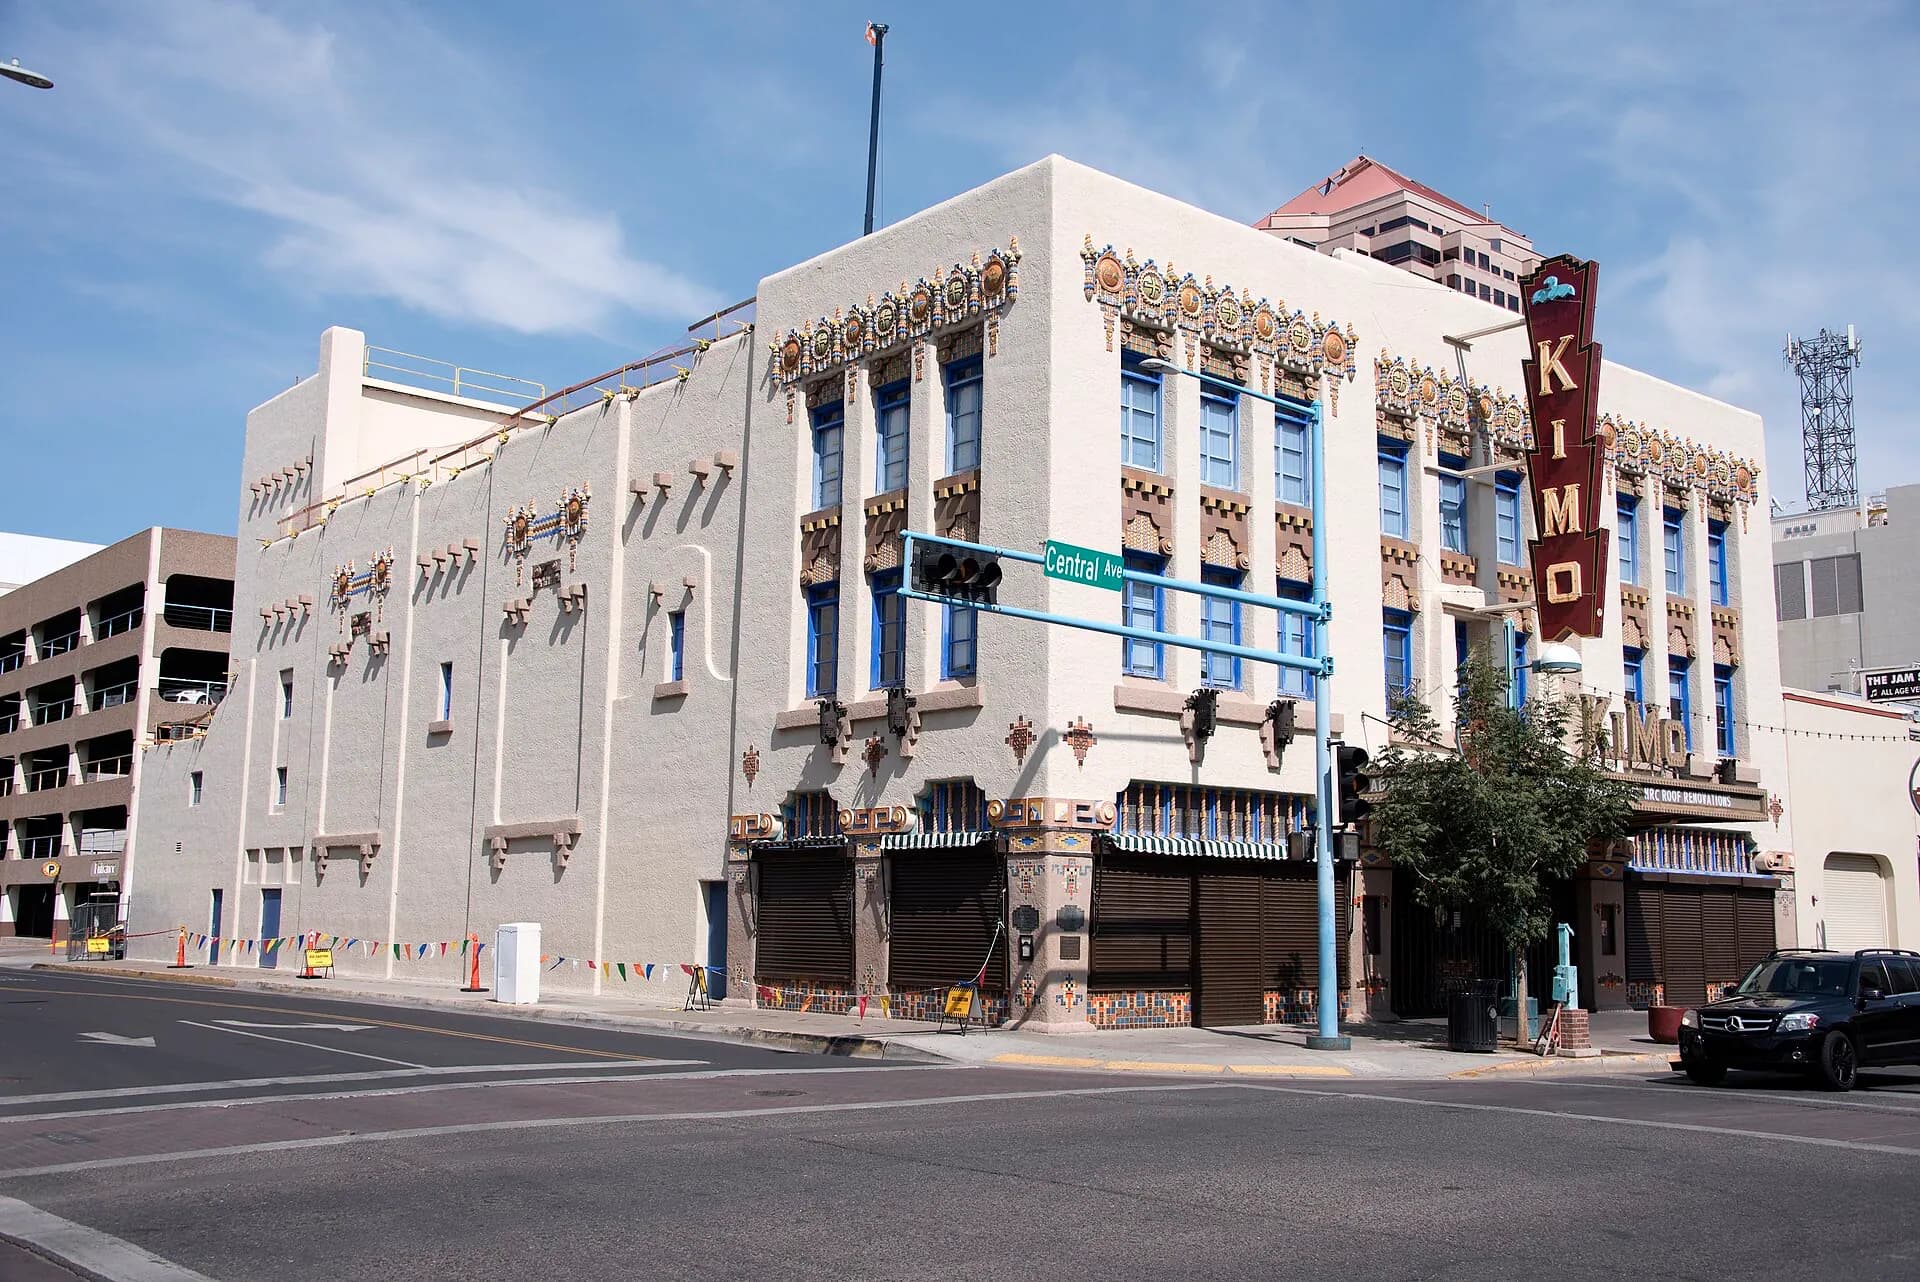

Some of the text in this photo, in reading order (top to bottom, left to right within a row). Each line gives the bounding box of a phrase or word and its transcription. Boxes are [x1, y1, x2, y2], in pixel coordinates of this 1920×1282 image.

[1537, 334, 1583, 604] KIMO
[1046, 545, 1123, 581] Central Ave
[1866, 675, 1888, 686] THE
[1890, 672, 1915, 684] JAM
[1880, 688, 1894, 696] ALL
[1894, 686, 1910, 695] AGE
[1661, 789, 1681, 803] ROOF
[1683, 791, 1732, 807] RENOVATIONS
